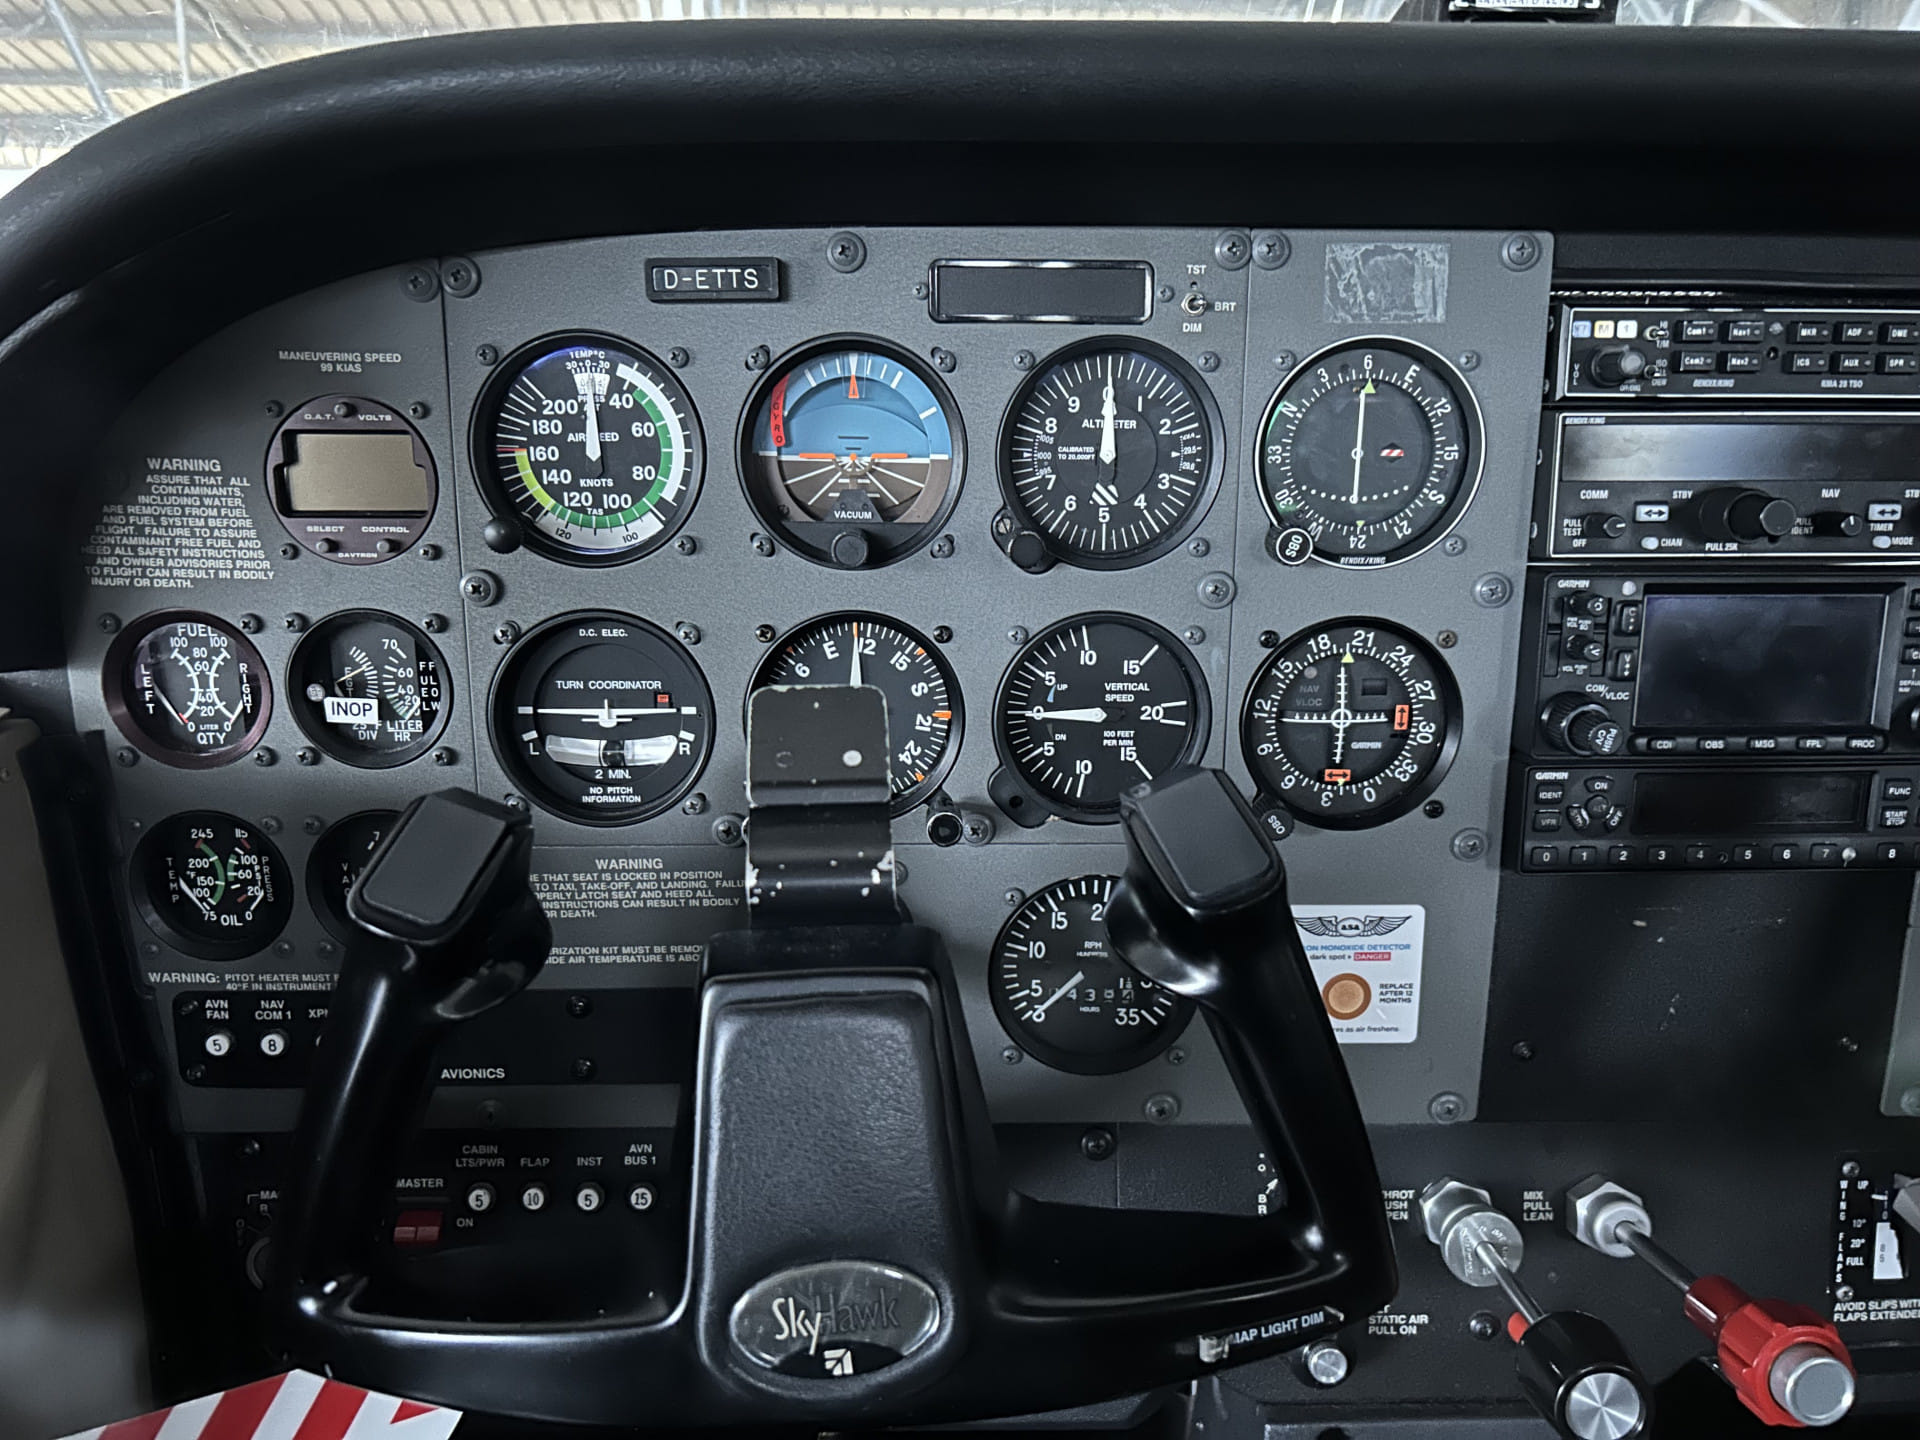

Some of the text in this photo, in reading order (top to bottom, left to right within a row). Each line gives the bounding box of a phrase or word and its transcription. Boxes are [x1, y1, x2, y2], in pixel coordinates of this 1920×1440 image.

[1187, 265, 1207, 274] TST
[664, 268, 758, 289] D-ETTS
[1214, 302, 1236, 312] BRT
[1183, 323, 1202, 332] DIM
[279, 351, 401, 363] MANEUVERING SPEED
[1364, 355, 1372, 369] 6
[320, 363, 362, 373] 99 KIAS
[1317, 368, 1329, 382] 3
[609, 394, 634, 409] 40
[1068, 397, 1080, 413] 9
[1434, 398, 1451, 416] 12
[542, 400, 578, 415] 200
[532, 420, 562, 435] 180
[631, 422, 654, 437] 60
[1045, 418, 1057, 433] 8
[1159, 419, 1171, 435] 2
[529, 446, 559, 461] 160
[1444, 444, 1458, 461] 15
[146, 458, 221, 472] WARNING
[542, 469, 572, 485] 140
[632, 466, 656, 481] 80
[146, 475, 250, 486] ASSURE THAT ALL
[580, 479, 613, 487] KNOTS
[1158, 474, 1170, 489] 3
[152, 486, 244, 497] CONTAMINANTS,
[1580, 491, 1608, 499] COMM
[1821, 489, 1840, 498] NAV
[138, 496, 245, 508] INCLUDING WATER,
[563, 492, 592, 507] 120
[603, 494, 632, 509] 100
[1065, 495, 1077, 511] 6
[1134, 494, 1146, 509] 4
[834, 511, 872, 519] VACUUM
[1098, 508, 1110, 522] 5
[1286, 535, 1303, 558] OBS
[1661, 538, 1683, 547] CHAN
[104, 567, 274, 579] FLIGHT CAN RESULT IN BODILY
[91, 578, 193, 588] INJURY OR DEATH.
[178, 625, 217, 637] FUEL
[580, 629, 628, 637] D.C. ELEC.
[1308, 634, 1331, 652] 18
[1352, 630, 1375, 646] 21
[382, 639, 397, 649] 70
[193, 648, 207, 658] 80
[1080, 651, 1096, 665] 10
[1390, 646, 1415, 667] 24
[194, 662, 209, 671] 60
[890, 651, 911, 671] 15
[1123, 660, 1140, 675] 15
[1272, 659, 1293, 678] 15
[1045, 672, 1056, 685] 5
[556, 681, 662, 689] TURN COORDINATOR
[1105, 683, 1150, 691] VERTICAL
[1415, 681, 1436, 701] 27
[1105, 694, 1134, 702] SPEED
[331, 702, 372, 717] INOP
[1140, 706, 1163, 720] 20
[386, 720, 422, 730] LITER
[395, 732, 410, 741] HR
[1417, 721, 1435, 744] 30
[197, 733, 226, 744] QTY
[1755, 739, 1775, 748] MSG
[1852, 738, 1875, 748] PROC
[529, 743, 539, 755] L
[679, 743, 690, 755] R
[1656, 740, 1672, 749] CDI
[898, 740, 921, 765] 24
[1121, 747, 1137, 761] 15
[1076, 760, 1092, 774] 10
[595, 770, 631, 779] 2 MIN.
[1536, 772, 1568, 780] GARMIN
[191, 829, 213, 839] 245
[1620, 851, 1628, 860] 2
[1783, 849, 1790, 859] 6
[188, 859, 209, 868] 200
[595, 859, 663, 869] WARNING
[543, 874, 570, 882] THAT
[573, 873, 599, 881] SEAT
[615, 872, 657, 880] LOCKED
[674, 871, 722, 879] POSITION
[612, 891, 639, 899] SEAT
[221, 915, 243, 926] OIL
[1051, 912, 1068, 930] 15
[148, 973, 220, 983] WARNING:
[302, 974, 330, 982] MUST
[205, 1000, 228, 1008] AVN
[261, 1000, 284, 1008] NAV
[206, 1011, 229, 1019] FAN
[255, 1012, 282, 1020] COM
[1115, 1008, 1140, 1025] 35
[441, 1068, 505, 1079] AVIONICS
[520, 1158, 550, 1167] FLAP
[577, 1157, 602, 1166] INST
[397, 1179, 444, 1188] MASTER
[1524, 1202, 1552, 1210] PULL
[1524, 1212, 1553, 1221] LEAN
[1834, 1300, 1897, 1311] AVOID SLIPS
[772, 1289, 900, 1355] SkyHawk
[1369, 1315, 1428, 1324] STATIC AIR
[1261, 1312, 1324, 1339] LIGHT DIM
[1369, 1326, 1417, 1334] PULL ON
